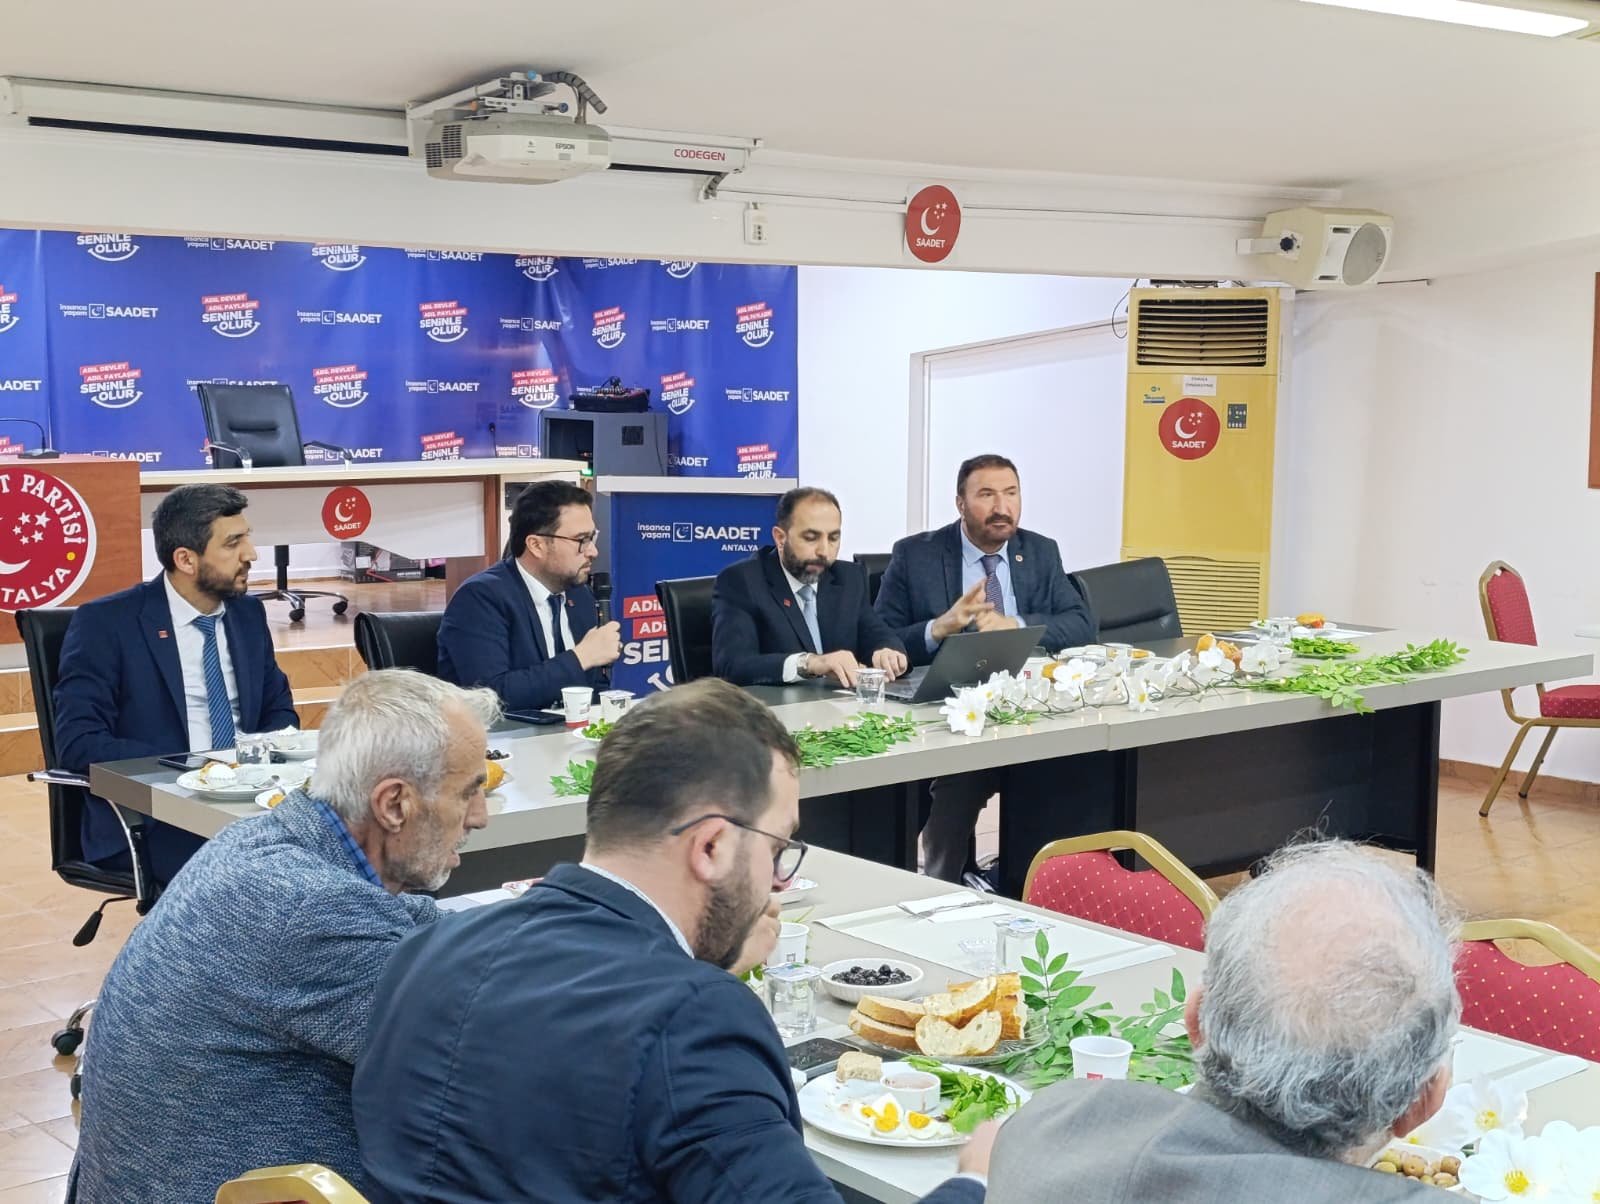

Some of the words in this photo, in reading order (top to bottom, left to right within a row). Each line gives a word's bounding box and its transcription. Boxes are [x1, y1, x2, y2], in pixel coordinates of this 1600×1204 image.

[555, 142, 576, 150] EPSON
[673, 148, 726, 161] CODEGEN
[95, 243, 131, 253] OLUR
[226, 239, 275, 251] SAADET
[915, 237, 946, 249] SAADET
[327, 253, 359, 264] OLUR
[440, 251, 484, 262] SAADET
[106, 306, 159, 318] SAADET
[336, 312, 382, 324] SAADET
[219, 319, 253, 330] OLUR
[431, 323, 461, 336] OLUR
[676, 319, 710, 330] SAADET
[601, 330, 621, 343] OLUR
[746, 328, 769, 341] OLUR
[0, 379, 42, 391] AADET
[438, 381, 481, 392] SAADET
[99, 389, 134, 401] OLUR
[329, 390, 362, 402] OLUR
[525, 393, 554, 403] OLUR
[752, 390, 790, 401] SAADET
[1171, 440, 1207, 449] SAADET
[110, 452, 162, 463] SAADET
[20, 474, 87, 544] PARTİSİ
[333, 521, 362, 532] SAADET
[641, 531, 671, 541] yaşam
[694, 526, 761, 541] SAADET
[721, 544, 759, 552] ANTALYA
[0, 567, 72, 604] TALYA
